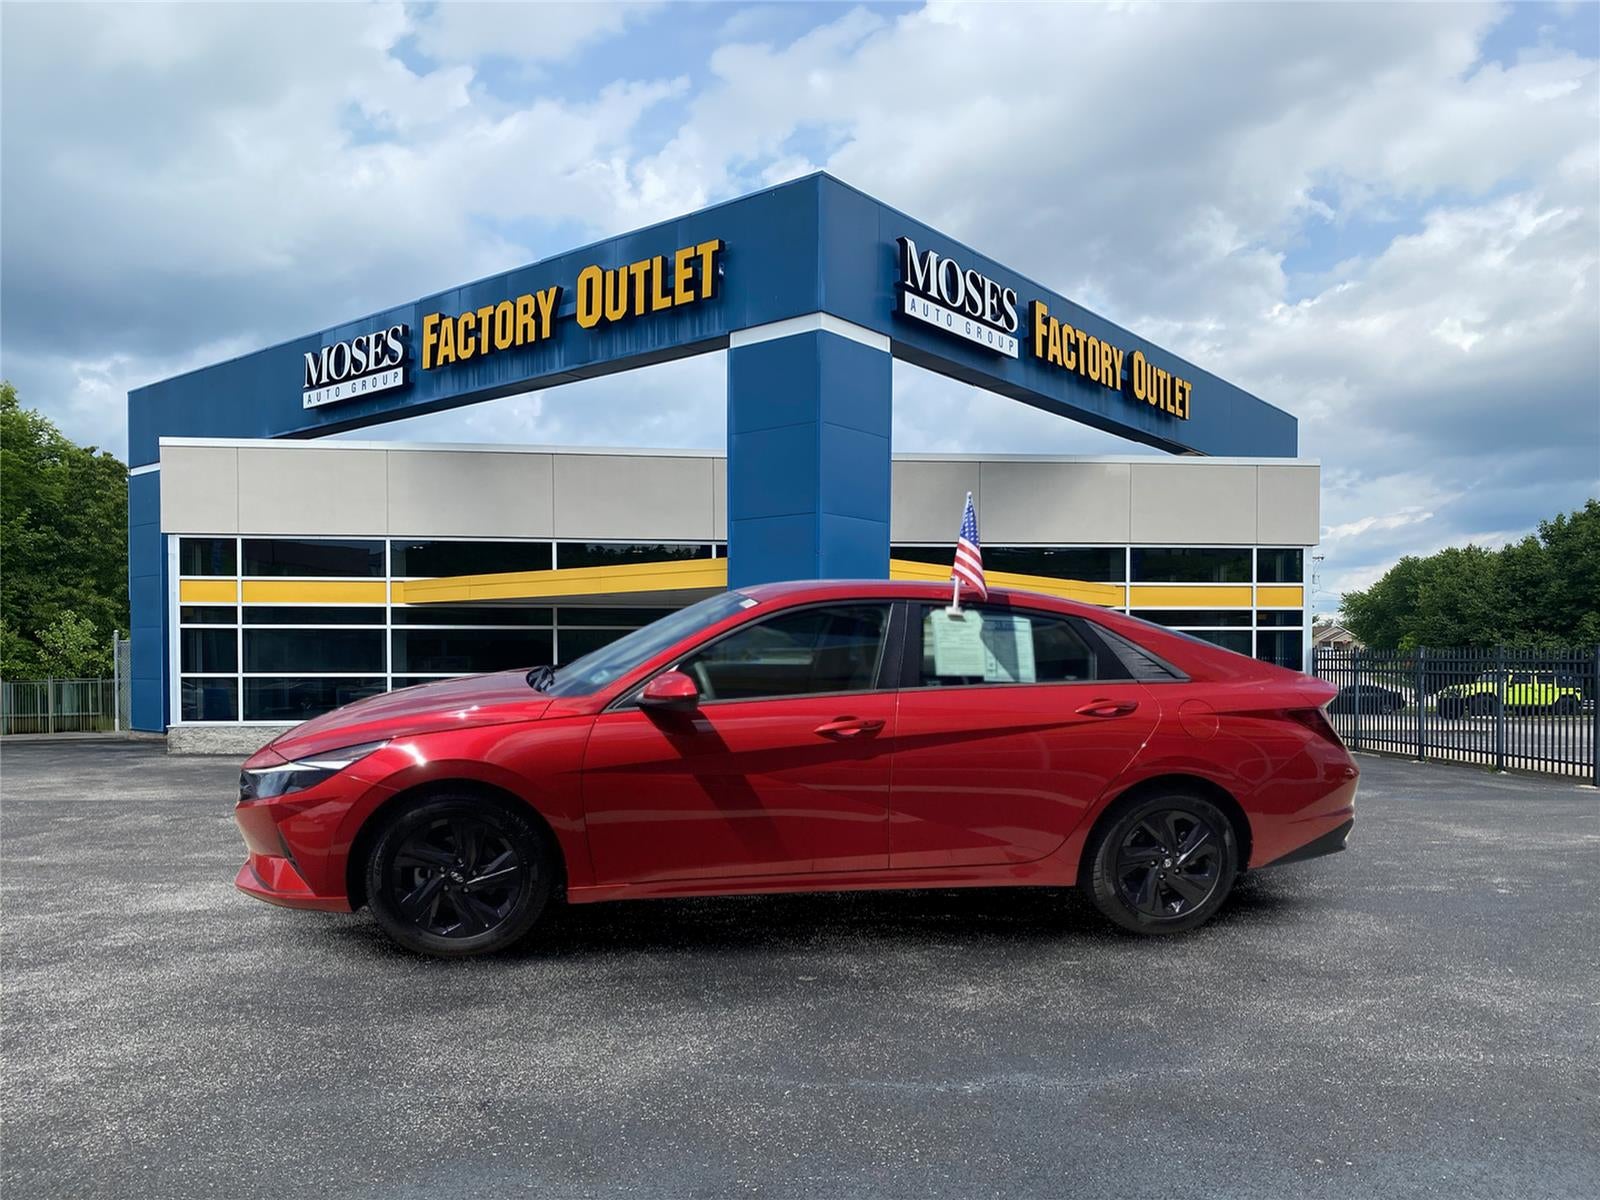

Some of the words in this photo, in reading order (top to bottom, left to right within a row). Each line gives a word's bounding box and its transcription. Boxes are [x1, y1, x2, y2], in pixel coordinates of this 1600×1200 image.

[422, 286, 559, 369] FACTORY
[576, 239, 720, 329] OUTLET
[904, 237, 1018, 333] MOSES
[910, 298, 952, 327] AUTO
[965, 322, 1015, 351] GROUP
[303, 325, 403, 388] MOSES
[307, 385, 340, 405] AUTO
[351, 371, 400, 393] GROUP
[1035, 300, 1123, 391] FACTORY
[1133, 350, 1192, 420] OUTLET
